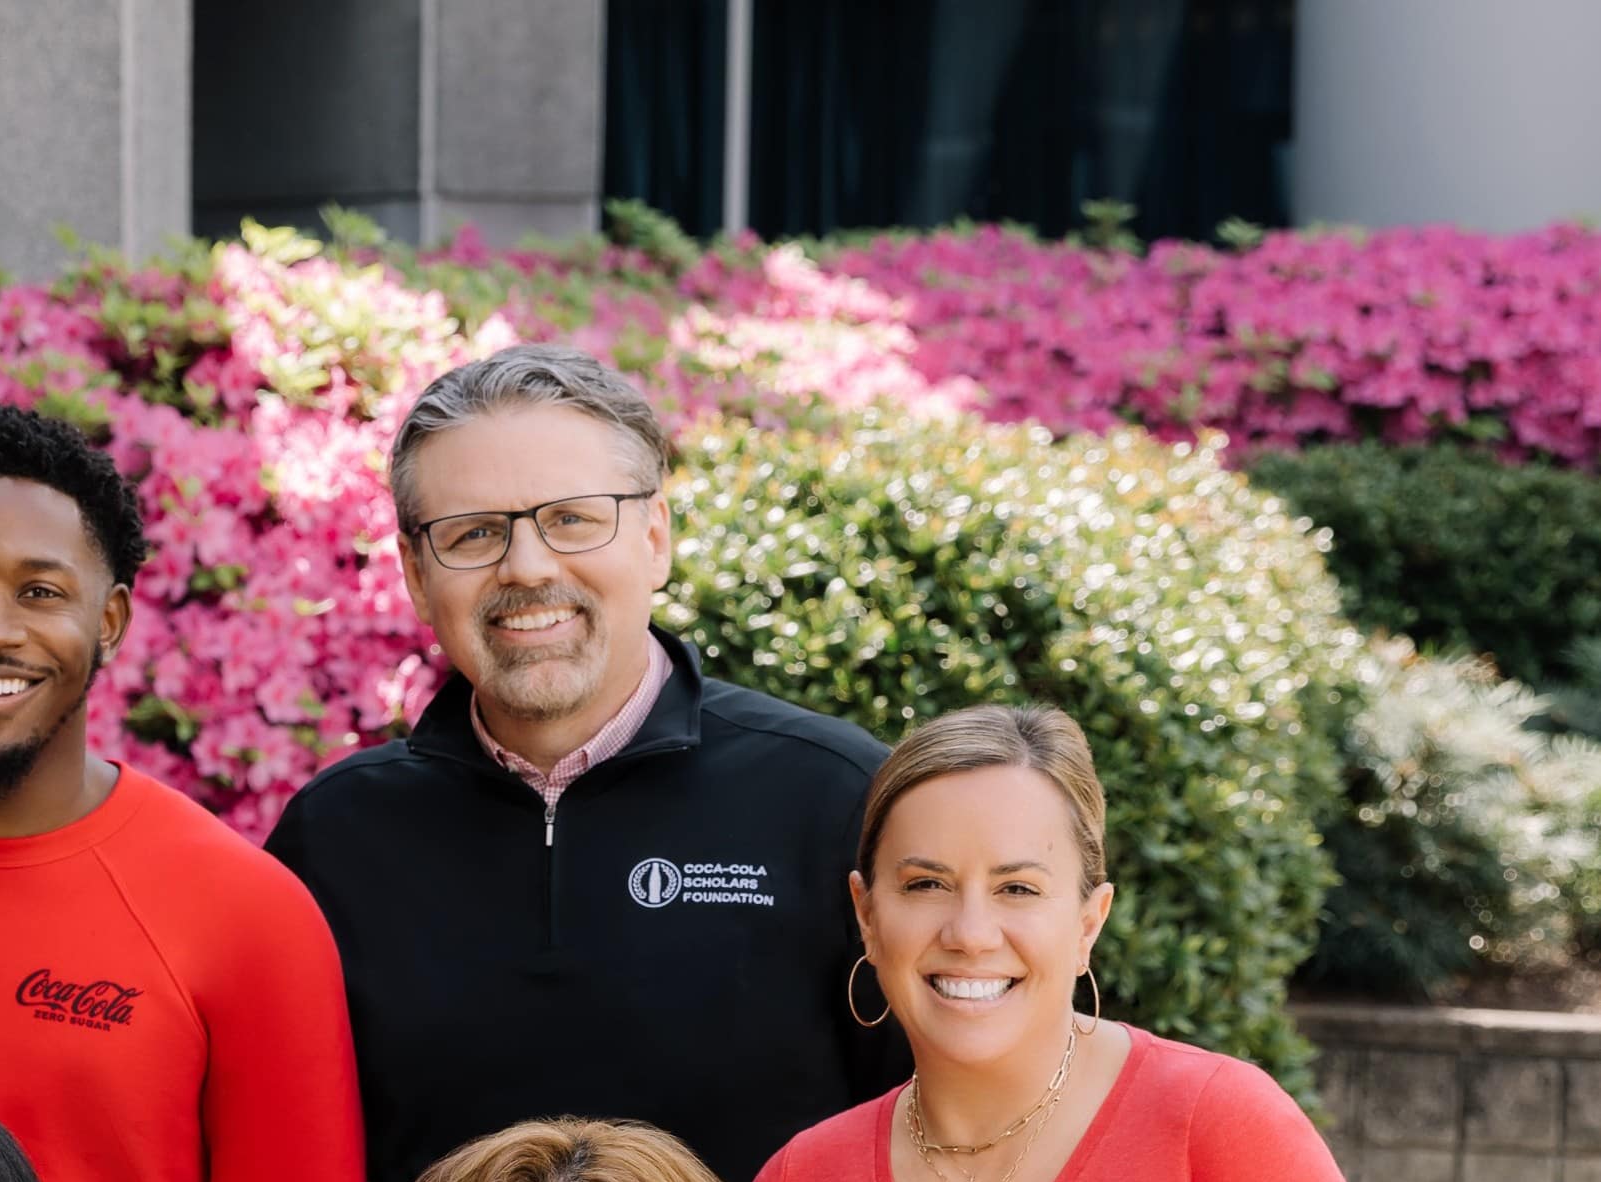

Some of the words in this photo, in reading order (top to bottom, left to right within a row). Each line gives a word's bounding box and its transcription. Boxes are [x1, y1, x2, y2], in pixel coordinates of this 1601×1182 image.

[683, 863, 767, 876] COCA-COLA
[683, 877, 758, 889] SCHOLARS
[683, 892, 774, 906] FOUNDATION
[13, 968, 144, 1025] Coca-Cola
[34, 1009, 66, 1023] ZERO
[70, 1017, 110, 1032] SUGAR
